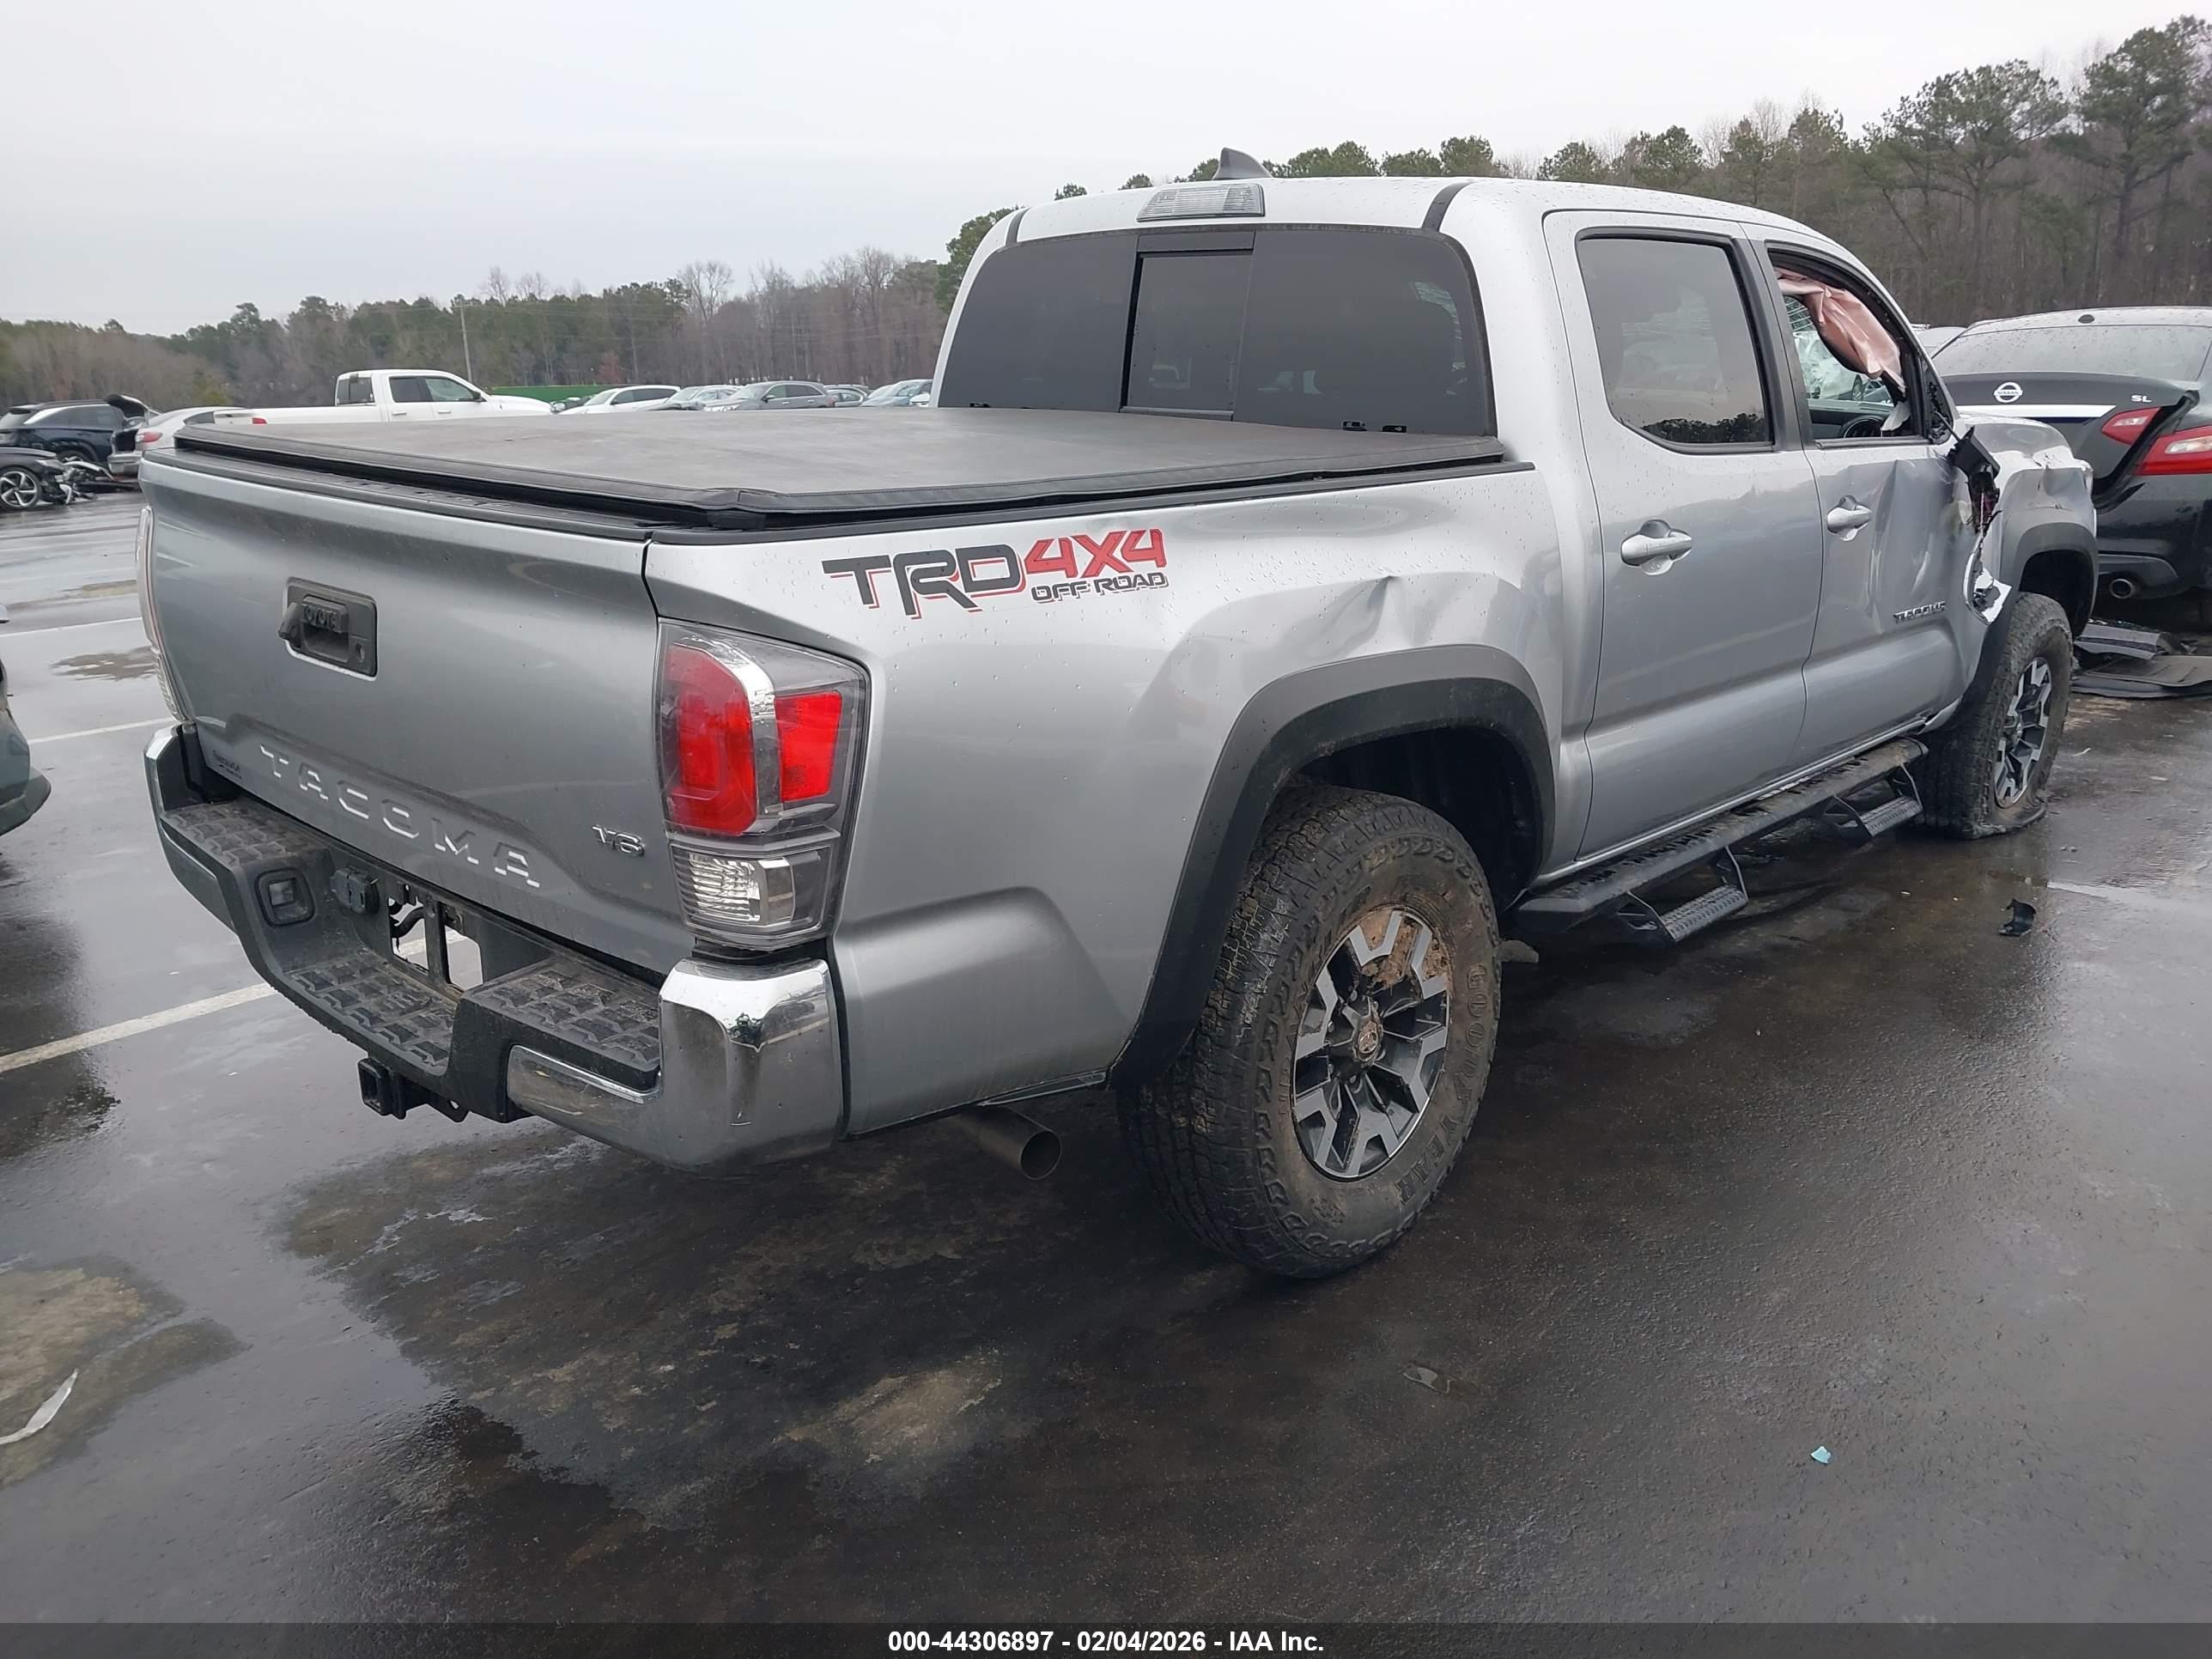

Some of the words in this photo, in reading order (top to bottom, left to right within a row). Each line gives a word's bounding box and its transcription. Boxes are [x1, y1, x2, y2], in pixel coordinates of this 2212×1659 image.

[2130, 394, 2153, 403] SL
[821, 543, 1027, 620] TRD
[1024, 528, 1168, 580] 4X4
[1030, 580, 1091, 604] OFF
[1094, 571, 1170, 597] ROAD
[1893, 599, 1947, 624] TACOMA
[259, 743, 541, 889] TACOMA
[591, 824, 646, 857] V6
